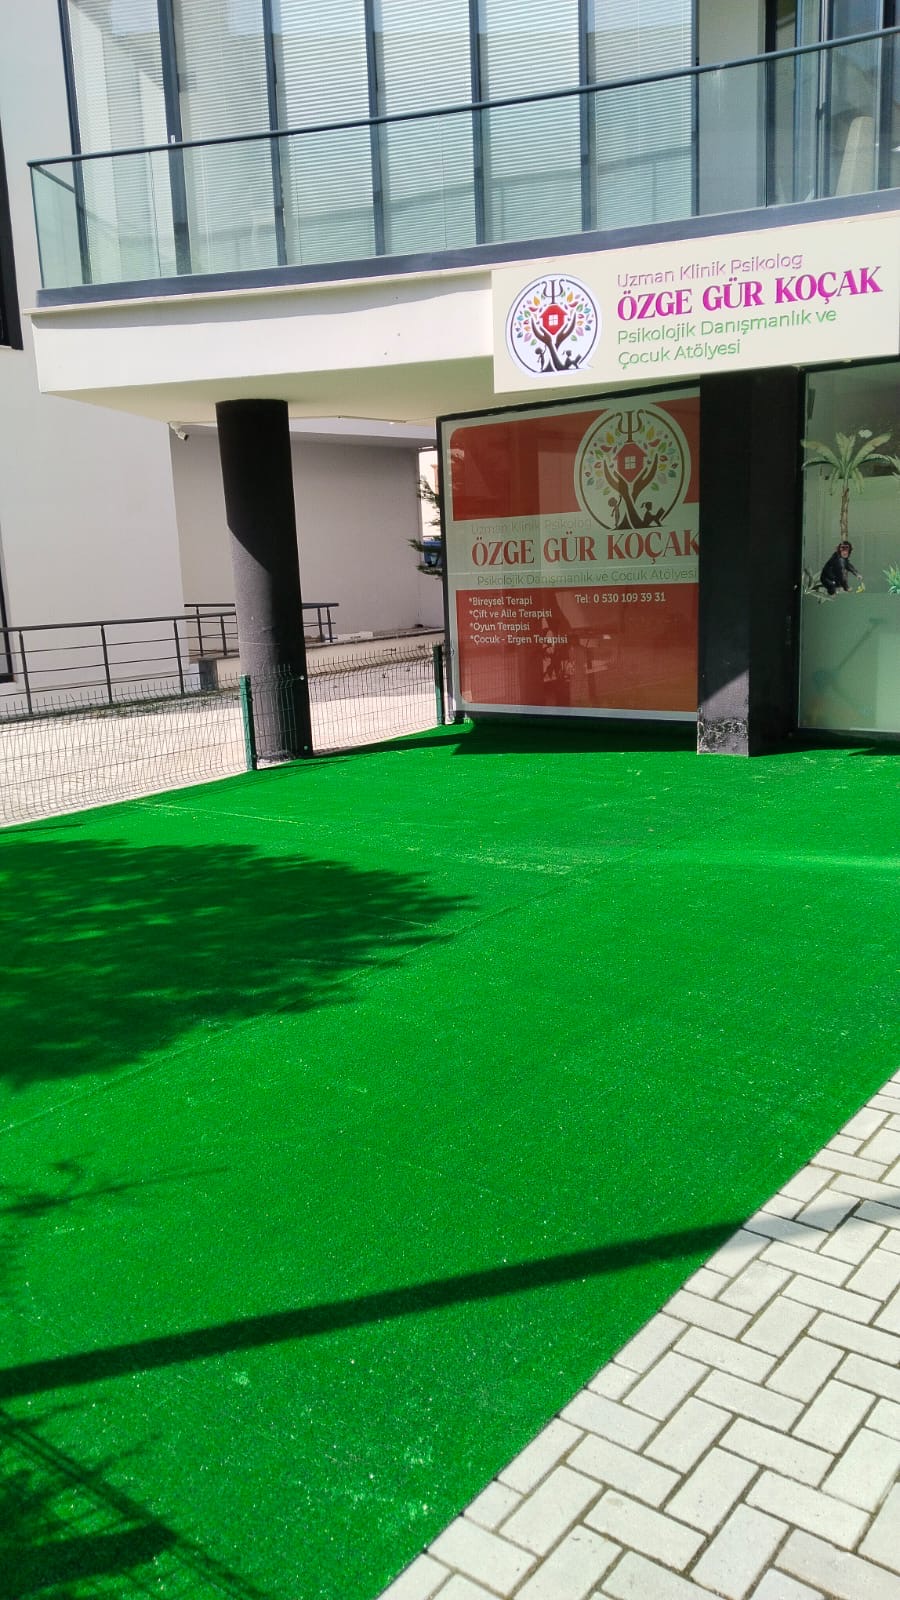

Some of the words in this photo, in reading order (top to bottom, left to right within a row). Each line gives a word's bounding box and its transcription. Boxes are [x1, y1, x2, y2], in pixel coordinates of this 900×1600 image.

[617, 270, 674, 287] Uzman
[680, 261, 726, 280] Klinik
[731, 253, 802, 274] Psikolog
[617, 290, 693, 320] ÖZGE
[702, 277, 765, 311] GÜR
[775, 266, 883, 304] KOÇAK
[618, 322, 696, 344] Psikolojik
[701, 309, 812, 335] Danışmanlık
[815, 310, 837, 322] ve
[618, 347, 670, 370] Çocuk
[674, 339, 740, 360] Atölyesi
[471, 536, 534, 567] ÖZGE
[543, 531, 597, 563] GÜR
[607, 529, 699, 564] KOÇAK
[477, 573, 525, 586] Psikolojik
[596, 573, 609, 581] ve
[612, 570, 647, 582] Çocuk
[650, 568, 697, 580] Atölyesi
[506, 596, 533, 606] Terapi
[575, 594, 591, 603] Tel:
[593, 594, 600, 603] 0
[602, 593, 619, 603] 530
[621, 593, 638, 603] 109
[640, 592, 652, 602] 39
[655, 592, 666, 602] 31
[489, 611, 499, 619] ve
[501, 609, 517, 619] Aile
[519, 608, 553, 620] Terapisi
[497, 621, 530, 632] Terapisi
[507, 634, 532, 645] Ergen
[534, 634, 568, 645] Terapisi
